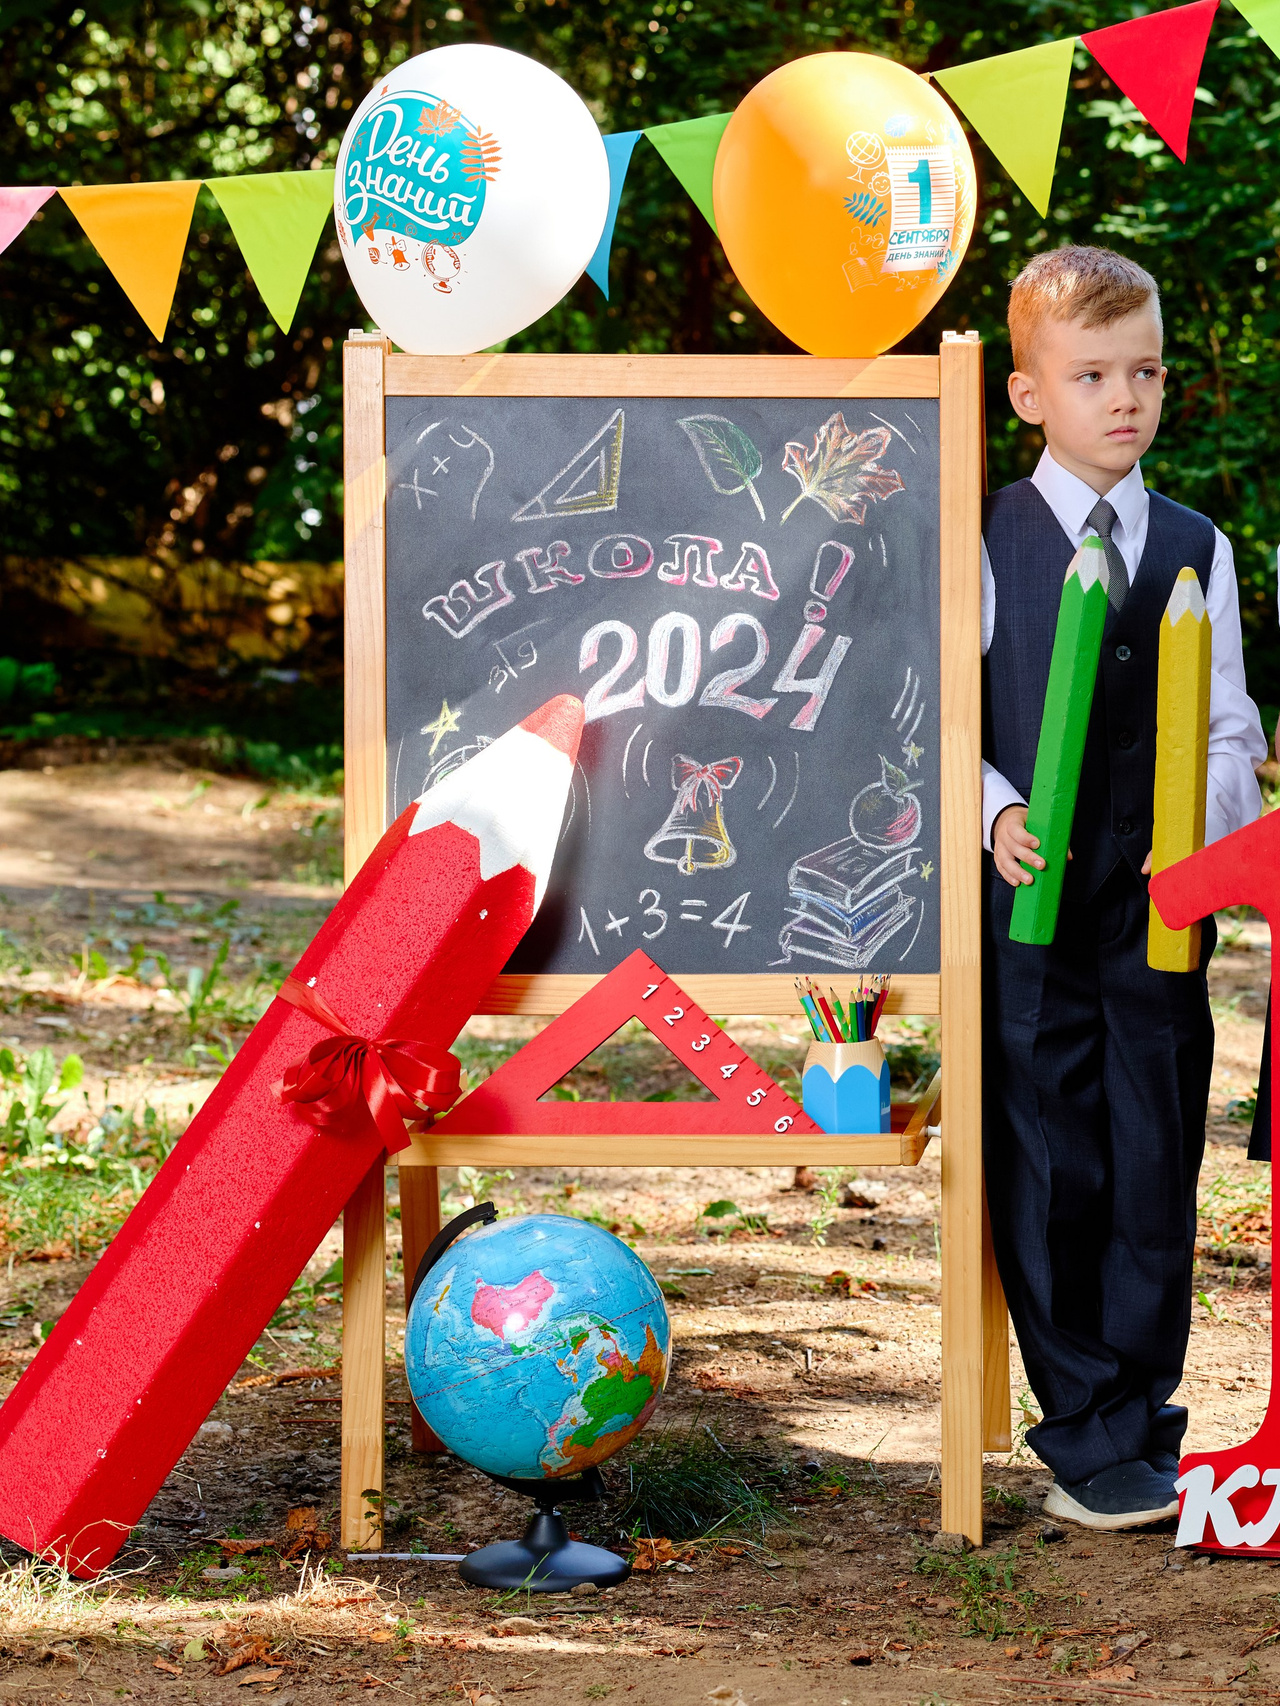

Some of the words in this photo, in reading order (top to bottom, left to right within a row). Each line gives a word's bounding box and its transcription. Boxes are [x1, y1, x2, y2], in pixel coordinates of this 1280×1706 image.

[365, 103, 450, 183] День
[344, 160, 477, 230] знаний
[907, 159, 931, 225] 1
[886, 250, 912, 263] ДЕНЬ
[913, 248, 945, 260] ЗНАНИЙ
[889, 228, 950, 245] СЕНТЯБРЯ
[579, 611, 853, 732] 2024
[642, 984, 659, 1000] 1
[663, 1006, 684, 1027] 2
[691, 1034, 711, 1052] 3
[719, 1063, 739, 1080] 4
[746, 1088, 767, 1107] 5
[774, 1115, 794, 1133] 6
